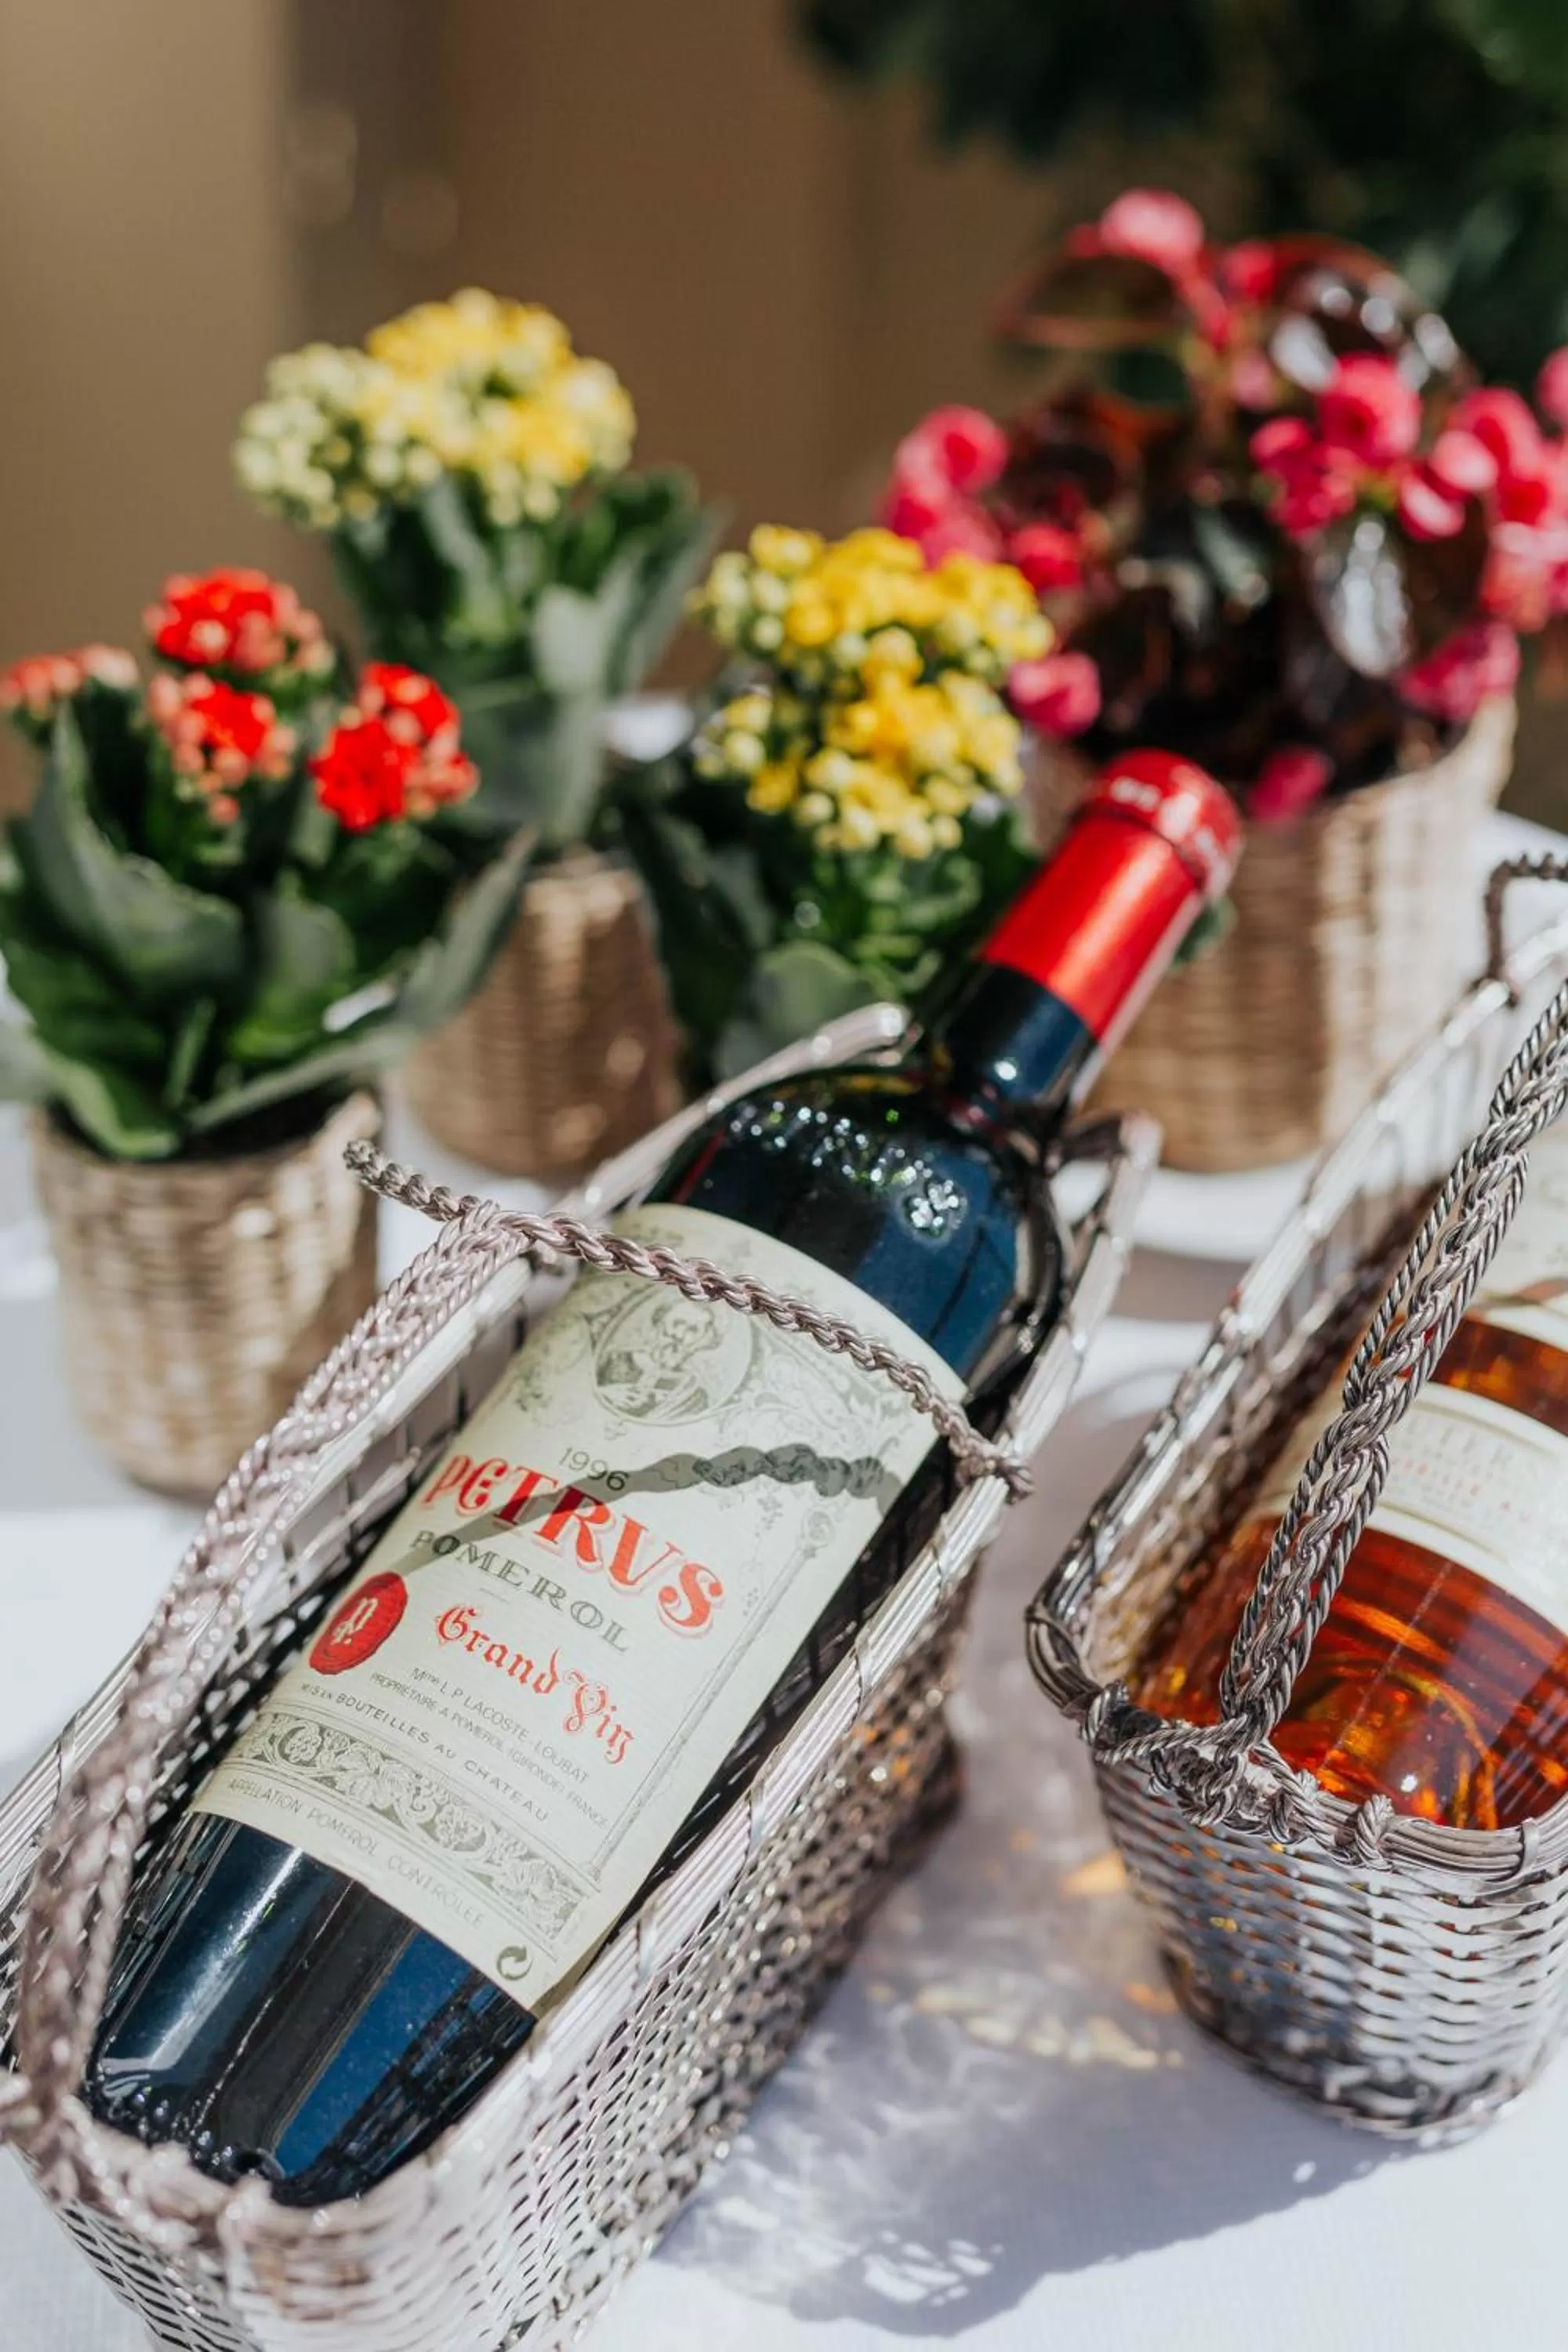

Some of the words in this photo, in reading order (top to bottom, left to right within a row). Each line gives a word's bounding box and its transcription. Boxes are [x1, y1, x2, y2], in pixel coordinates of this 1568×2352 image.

[558, 1446, 630, 1490] 1996
[408, 1530, 627, 1652] POMEROL
[435, 1605, 560, 1694] Grand
[563, 1670, 635, 1764] Vin
[335, 1692, 430, 1744] BOUTEILLES
[434, 1743, 457, 1759] AU
[306, 1807, 379, 1857] POMEROL
